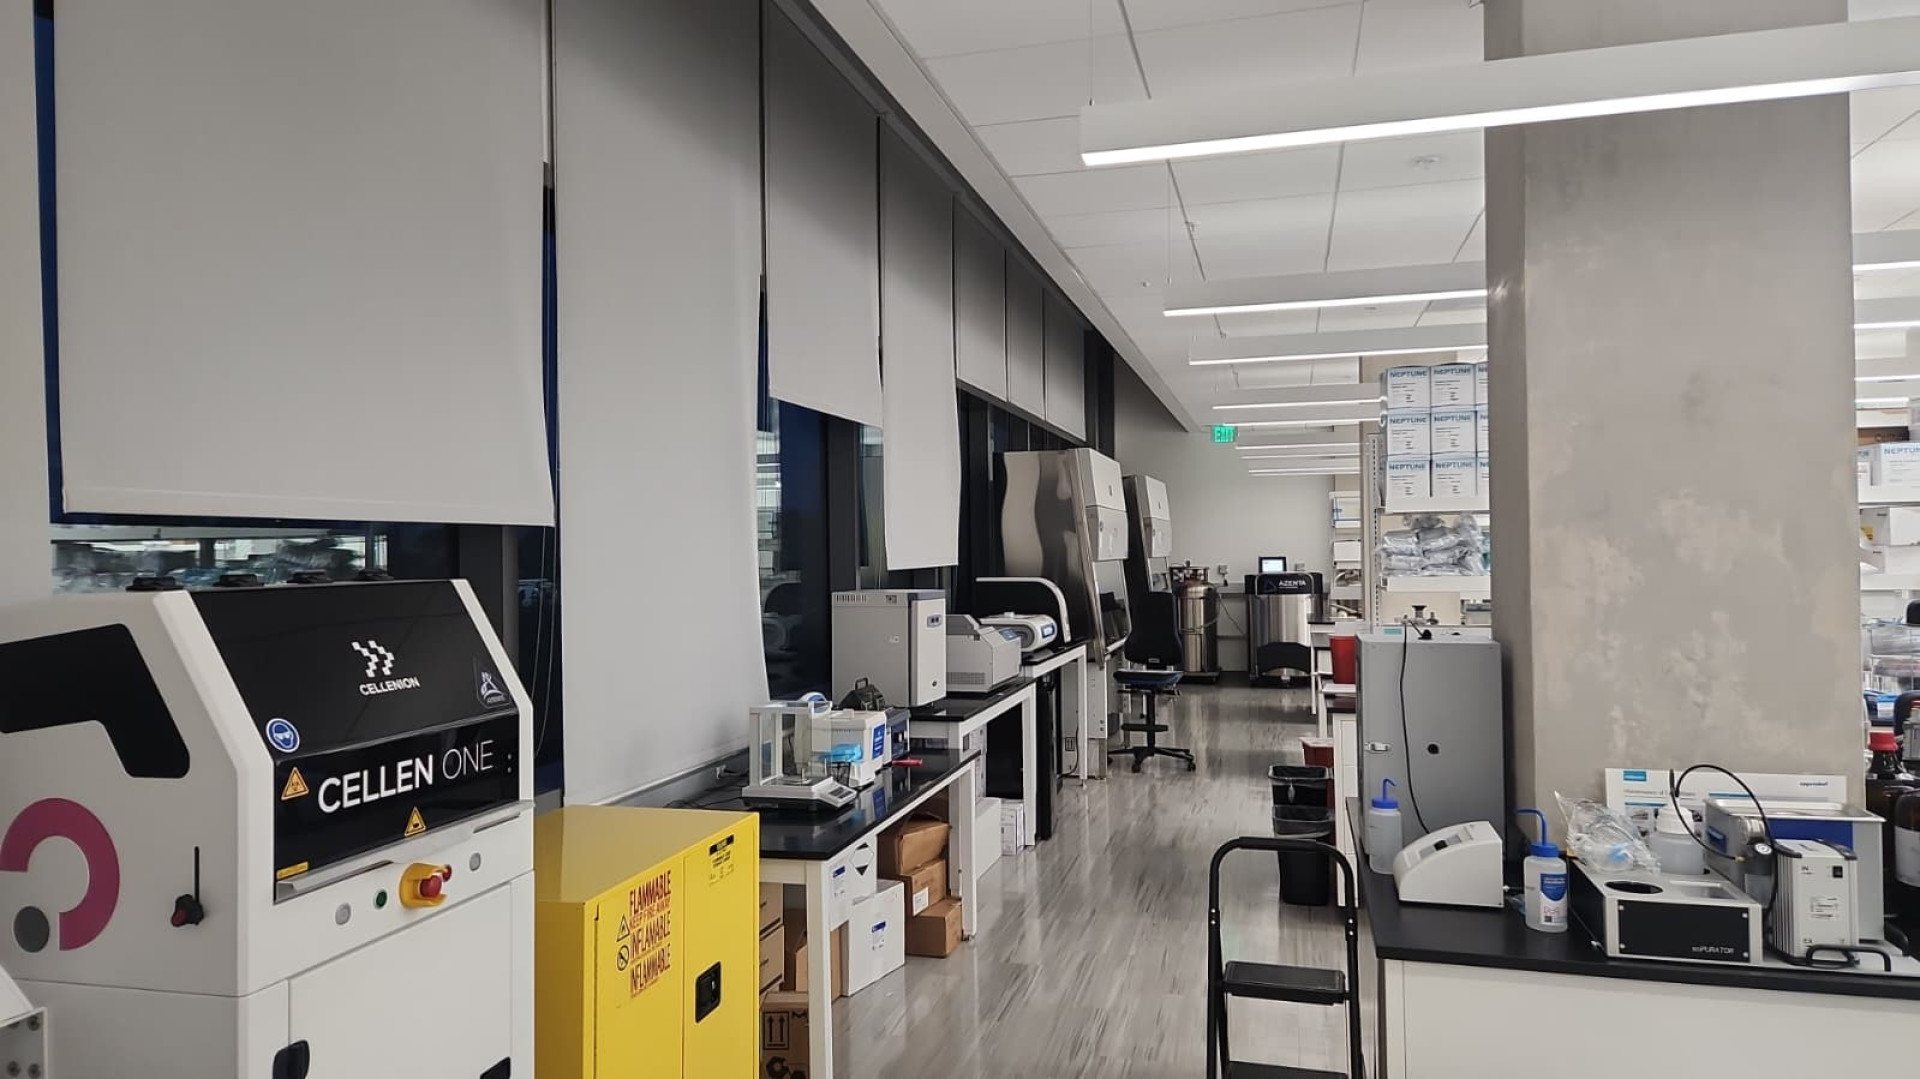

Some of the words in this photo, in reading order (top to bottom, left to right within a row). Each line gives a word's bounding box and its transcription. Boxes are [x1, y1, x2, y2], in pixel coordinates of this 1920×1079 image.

[1434, 414, 1471, 422] NEPTUNE
[1214, 426, 1234, 442] EXIT
[359, 677, 420, 696] CELLENION
[318, 754, 433, 813] CELLEN
[442, 740, 494, 779] ONE
[630, 870, 671, 914] FLAMMABLE
